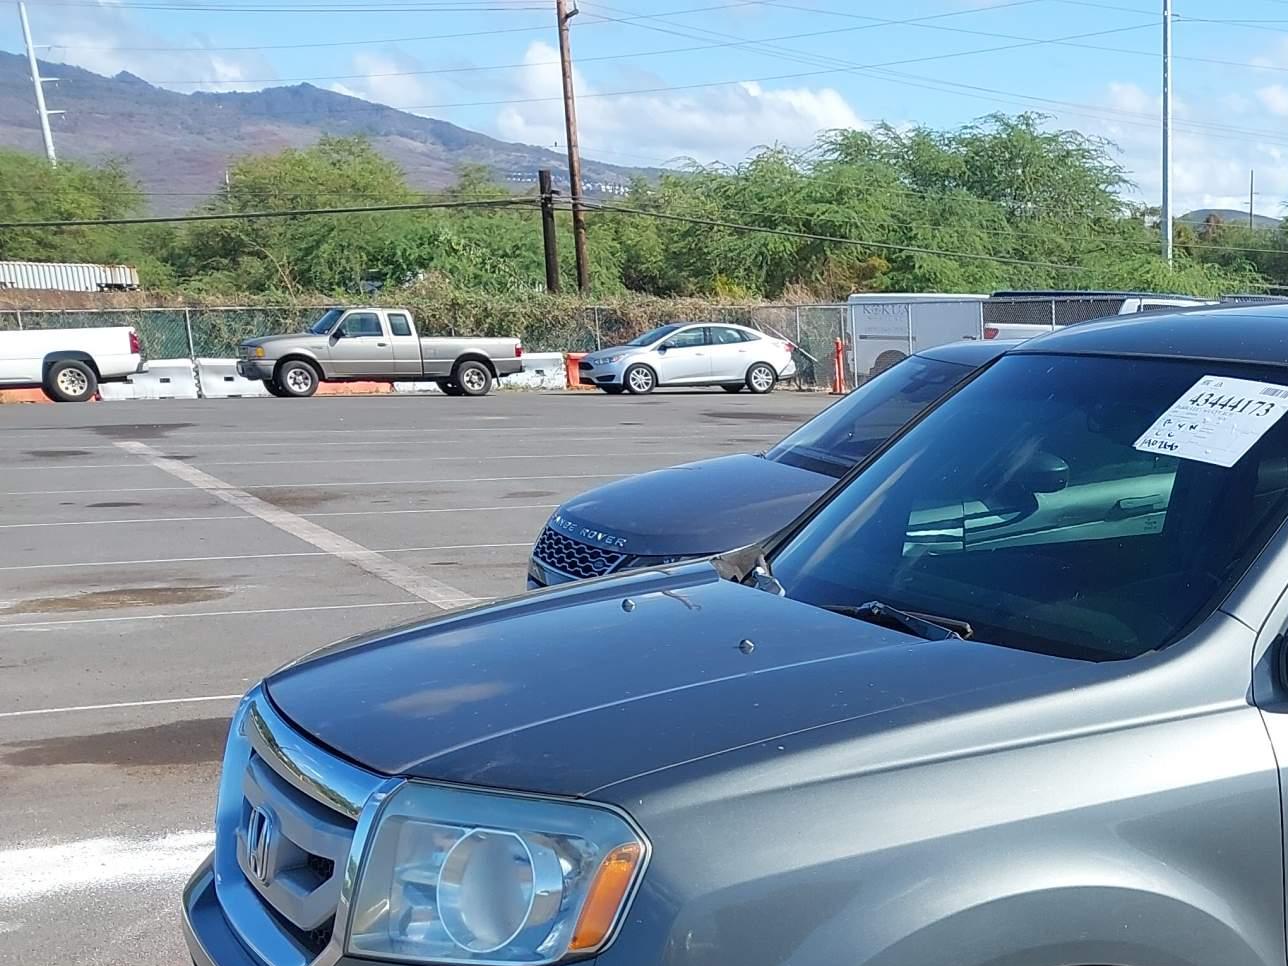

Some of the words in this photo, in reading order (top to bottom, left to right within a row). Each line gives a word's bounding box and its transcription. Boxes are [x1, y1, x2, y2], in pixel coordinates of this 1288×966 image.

[1188, 391, 1276, 417] 43444173
[551, 513, 578, 532] ANGE
[579, 527, 628, 547] ROVER
